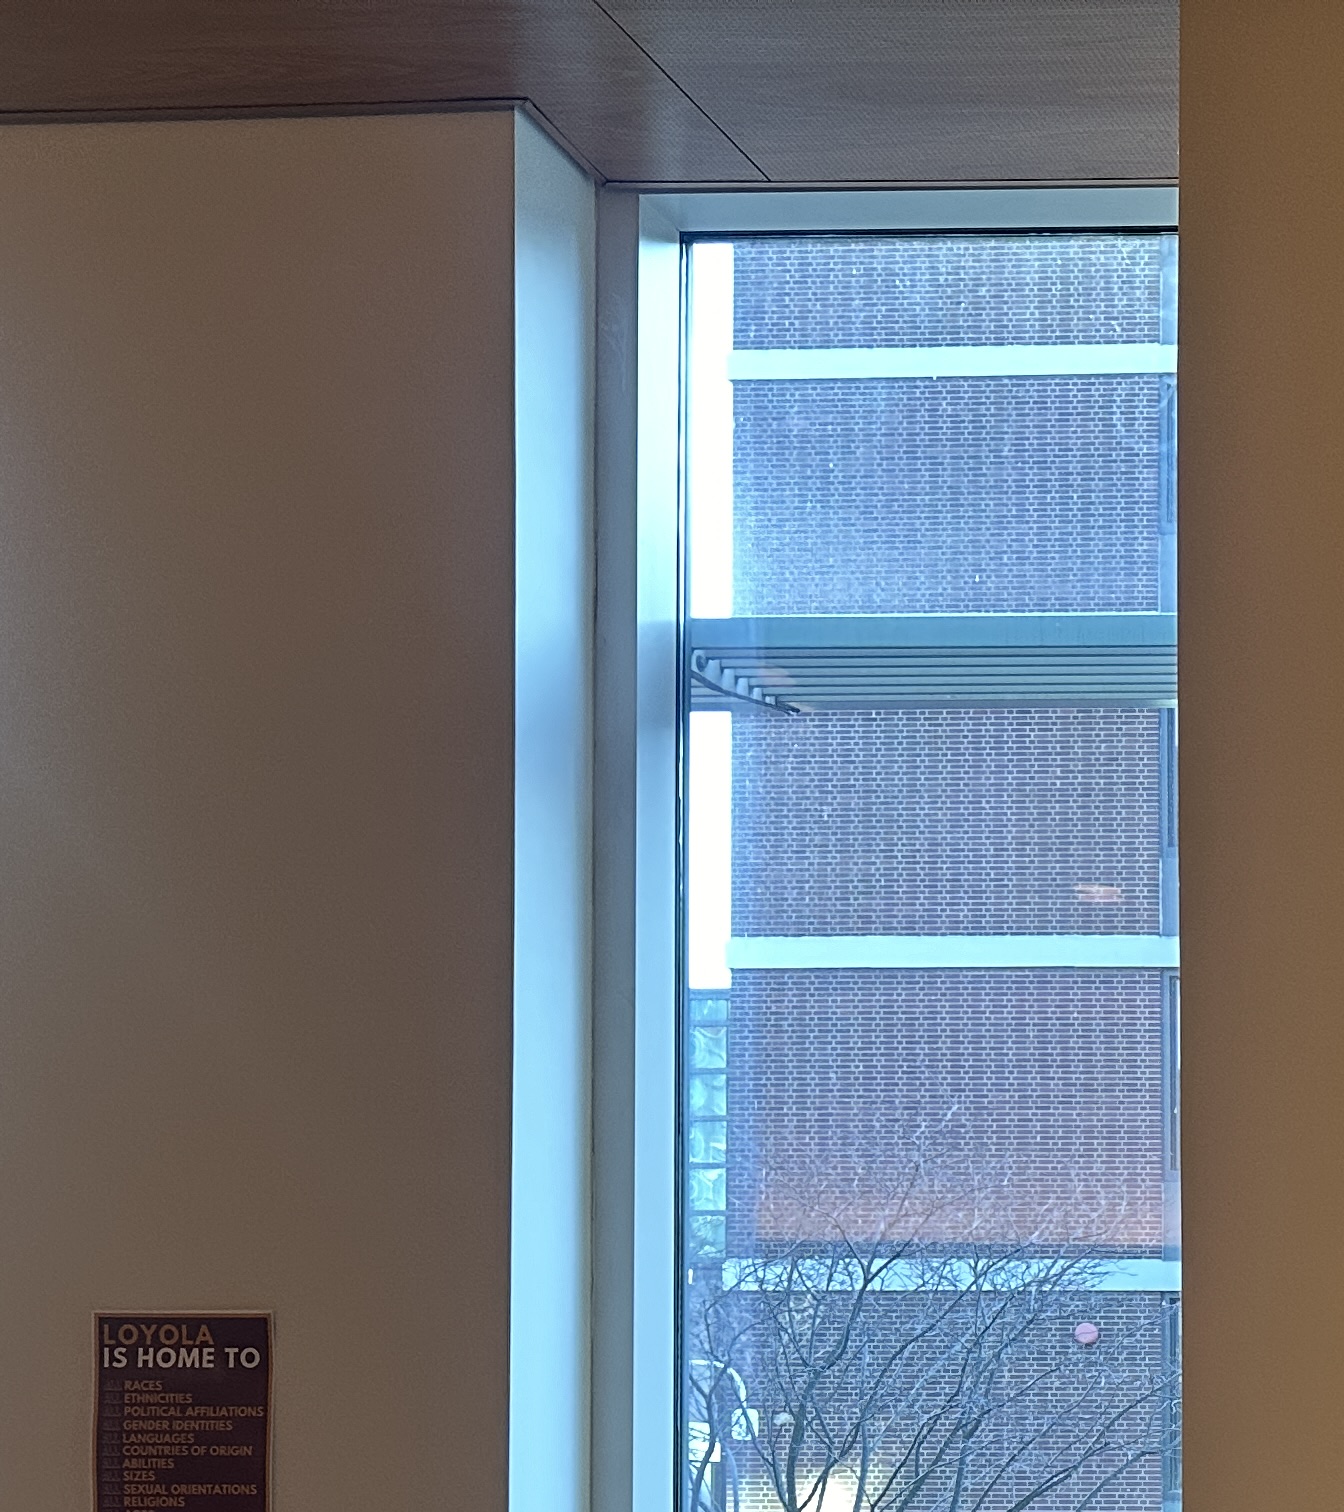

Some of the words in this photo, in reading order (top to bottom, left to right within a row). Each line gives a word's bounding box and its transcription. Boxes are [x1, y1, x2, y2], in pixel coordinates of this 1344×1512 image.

[103, 1324, 214, 1345] LOYOLA
[103, 1347, 128, 1369] IS
[137, 1347, 215, 1369] HOME
[224, 1347, 261, 1369] TO
[123, 1380, 163, 1391] RACES
[124, 1393, 193, 1404] ETHNICITIES
[124, 1406, 182, 1417] POLITICAL
[186, 1406, 264, 1417] AFFILIATIONS
[123, 1420, 170, 1431] GENDER
[172, 1420, 233, 1431] IDENTITIES
[122, 1433, 194, 1444] LANGUAGES
[122, 1446, 188, 1456] COUNTRIES
[191, 1446, 207, 1456] OF
[210, 1446, 253, 1456] ORIGIN
[122, 1458, 175, 1469] ABILITIES
[123, 1471, 155, 1481] SIZES
[123, 1484, 168, 1495] SEXUAL
[171, 1484, 257, 1495] ORIENTATIONS
[123, 1497, 185, 1507] RELIGIONS
